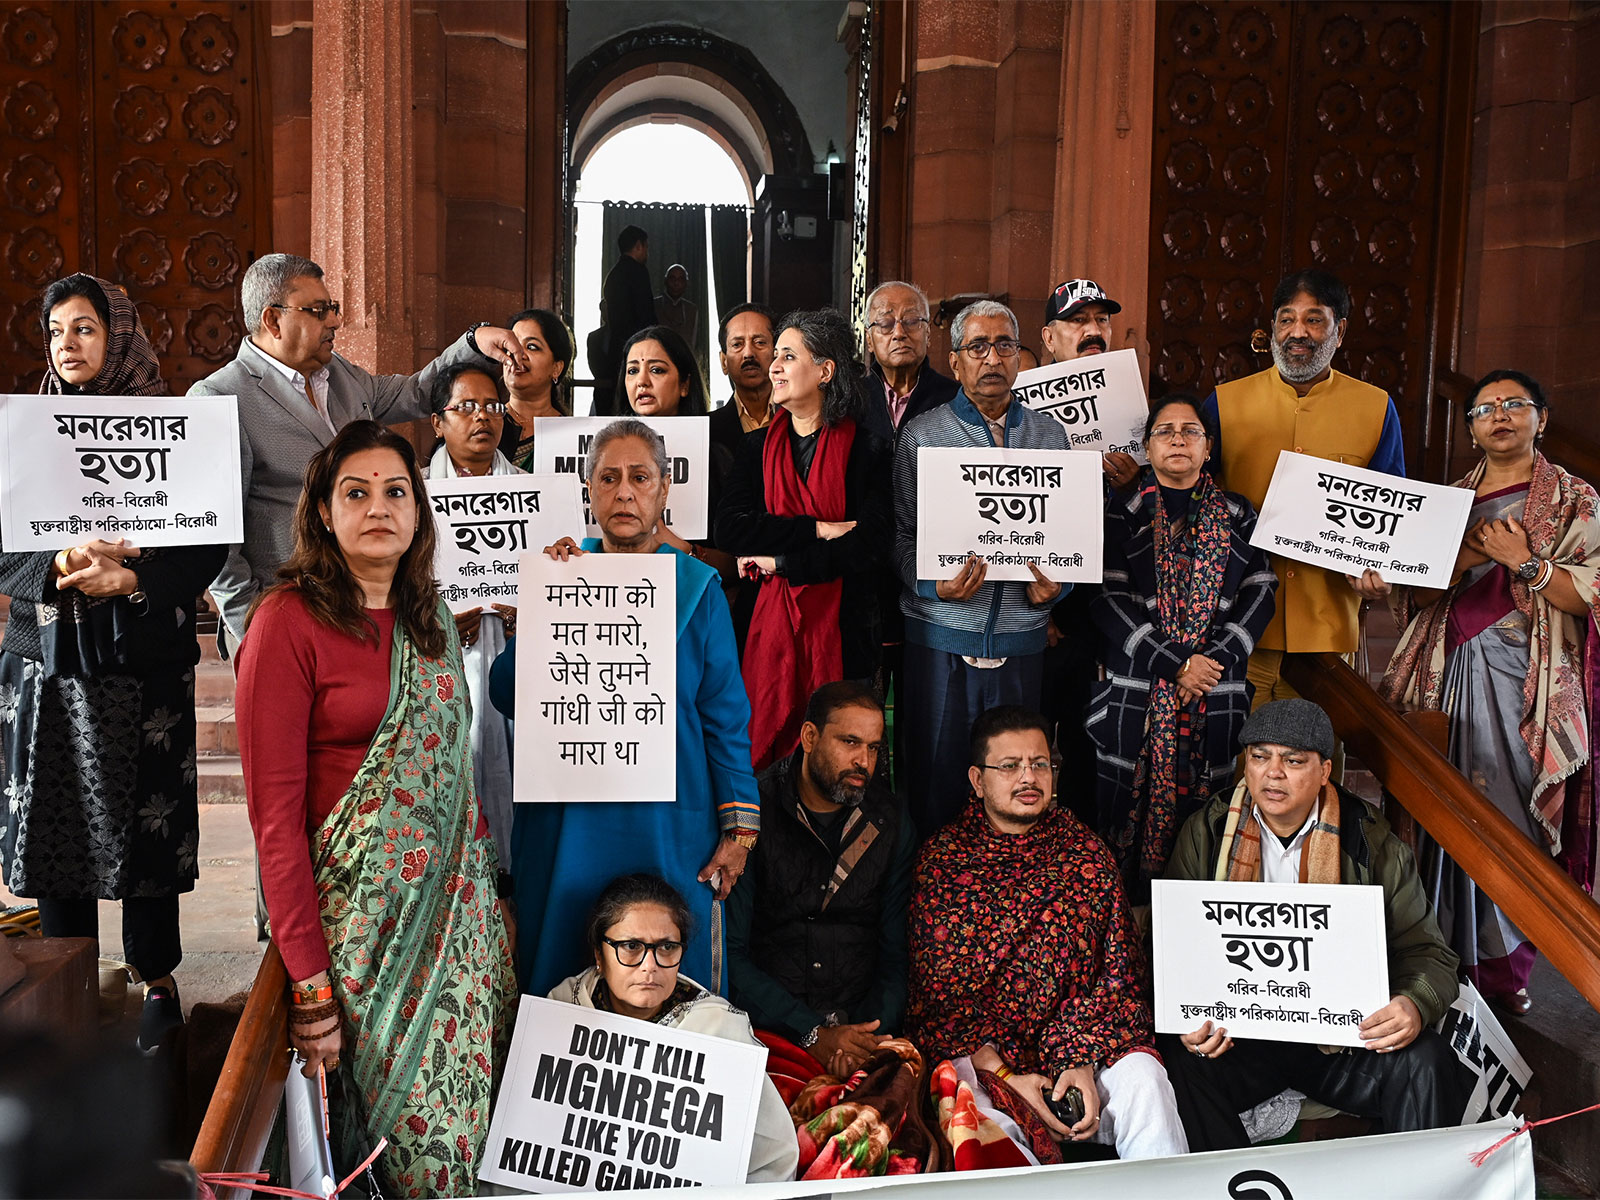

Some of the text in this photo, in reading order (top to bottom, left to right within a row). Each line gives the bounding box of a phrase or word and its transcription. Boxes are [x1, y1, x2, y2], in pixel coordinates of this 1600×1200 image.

[54, 415, 188, 441] মনরেগার
[75, 448, 170, 484] হত্যা
[960, 465, 1063, 488] মনরেগার
[431, 490, 541, 517] মনরেগার
[1316, 471, 1428, 512] মনরেগার
[975, 493, 1049, 524] হত্যা
[1325, 498, 1404, 536] হত্যা
[30, 515, 92, 536] যুক্তরাষ্ট্রীয়
[450, 519, 529, 555] হত্যা
[1274, 535, 1322, 554] যুক্তরাষ্ট্রীয়
[545, 577, 656, 608] मनरेगा को
[551, 615, 646, 649] मत मारो,
[549, 652, 651, 692] जैसे तुमने
[541, 693, 666, 725] गांधी जी को
[559, 742, 639, 765] मारा था
[1202, 901, 1331, 930] মনরেগার
[1222, 934, 1313, 972] হত্যা
[1179, 1001, 1237, 1021] যুক্তরাষ্ট্রীয়
[569, 1024, 706, 1084] DON'T KILL
[531, 1054, 724, 1142] MGNREGA
[561, 1114, 680, 1169] LIKE YOU
[498, 1138, 591, 1187] KILLED
